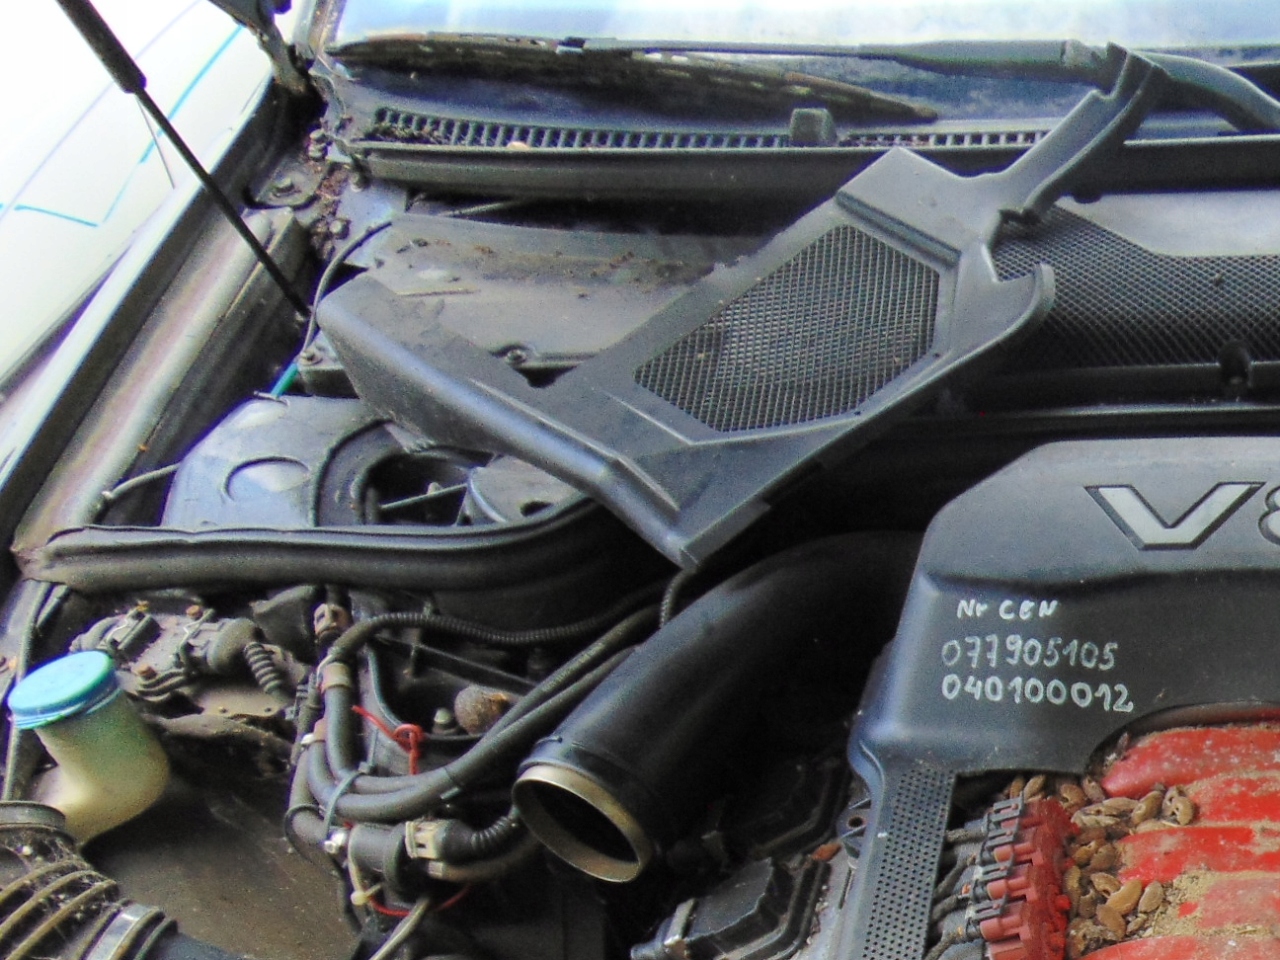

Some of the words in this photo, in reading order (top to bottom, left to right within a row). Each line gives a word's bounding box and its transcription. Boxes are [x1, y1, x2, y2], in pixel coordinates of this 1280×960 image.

[957, 599, 988, 619] Nr
[942, 634, 1118, 671] 077905105
[942, 673, 1134, 712] 040100012
